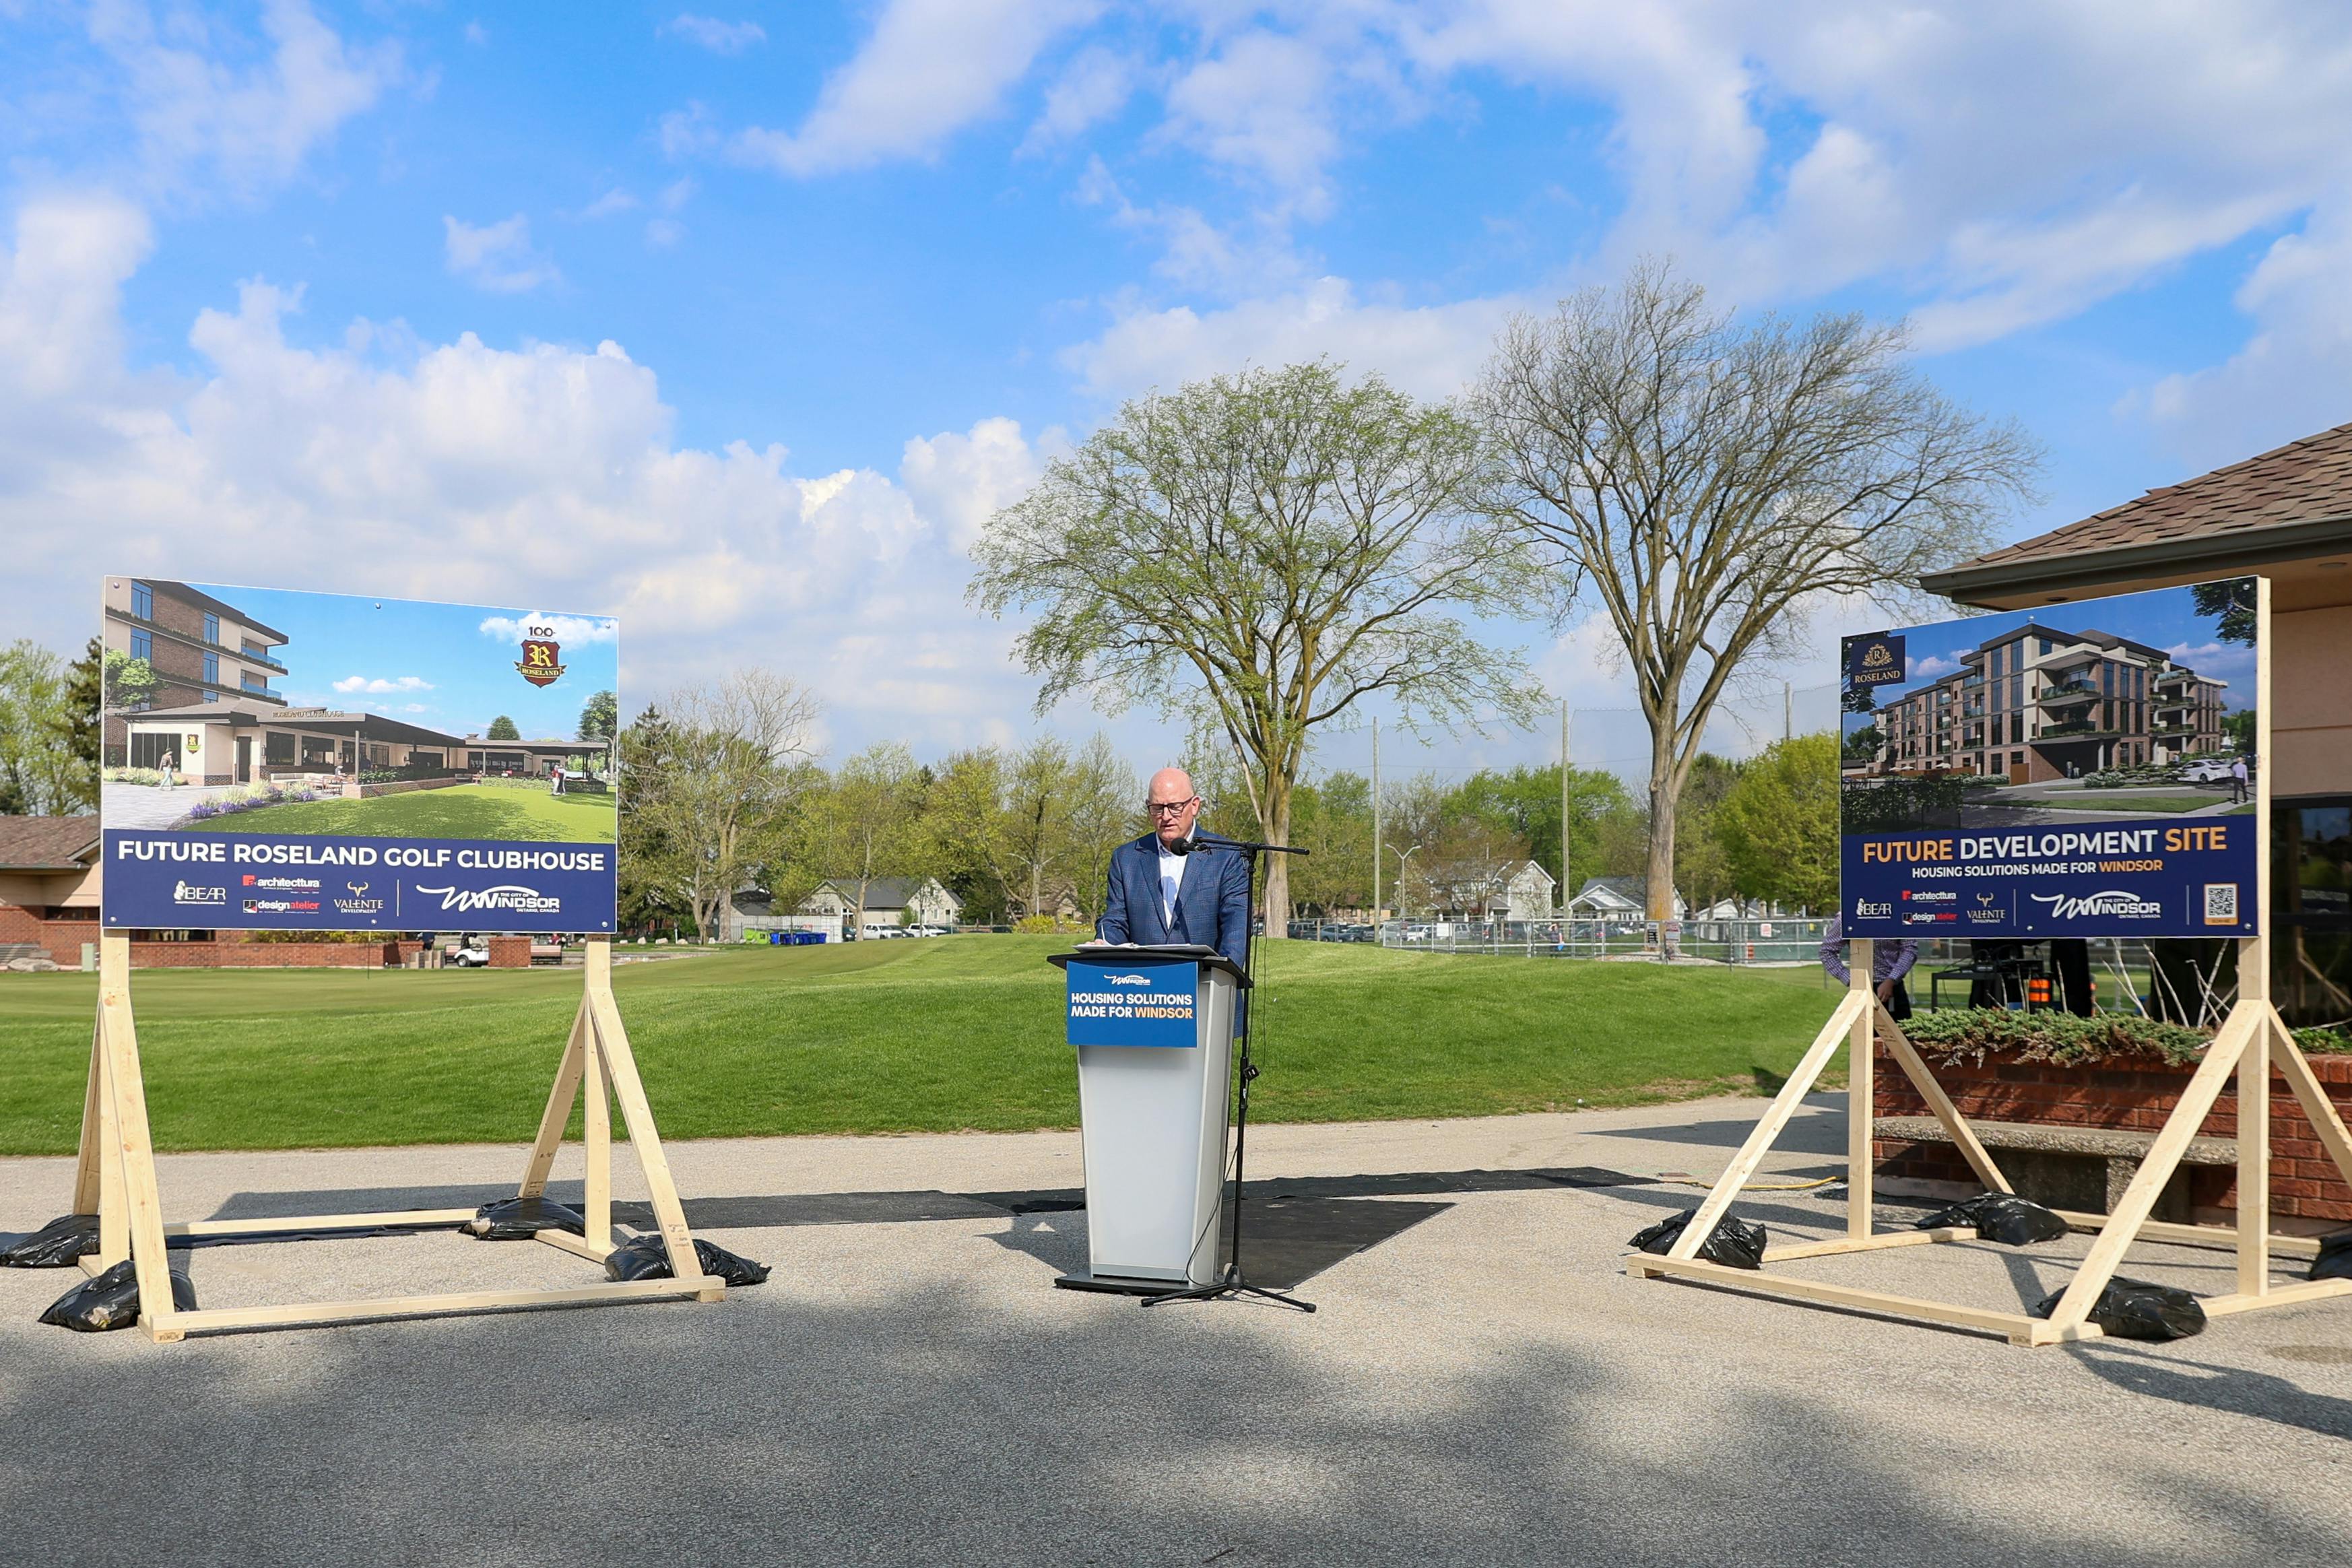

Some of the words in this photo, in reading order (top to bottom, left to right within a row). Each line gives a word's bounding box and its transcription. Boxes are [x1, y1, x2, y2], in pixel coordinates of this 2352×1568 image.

[528, 644, 554, 667] R
[1874, 650, 1881, 659] R
[522, 667, 559, 676] ROSELAND
[1854, 670, 1901, 684] ROSELAND
[1864, 839, 1953, 863] FUTURE
[1960, 829, 2158, 859] DEVELOPMENT
[2165, 826, 2227, 852] SITE
[118, 840, 226, 862] FUTURE
[234, 844, 378, 866] ROSELAND
[383, 847, 451, 868] GOLF
[457, 850, 604, 871] CLUBHOUSE
[1912, 866, 1963, 878] HOUSING
[1964, 863, 2030, 878] SOLUTIONS
[2032, 862, 2068, 875] MADE
[2070, 861, 2097, 874] FOR
[2099, 859, 2163, 873] WINDSOR
[184, 887, 226, 900] BEAR
[333, 899, 383, 909] VALENTE
[1864, 903, 1892, 915] BEAR
[1967, 909, 2006, 919] VALENTE
[1071, 993, 1124, 1004] HOUSING
[1126, 993, 1192, 1006] SOLUTIONS
[1071, 1006, 1106, 1018] MADE
[1109, 1006, 1132, 1018] FOR
[1134, 1007, 1193, 1019] WINDSOR
